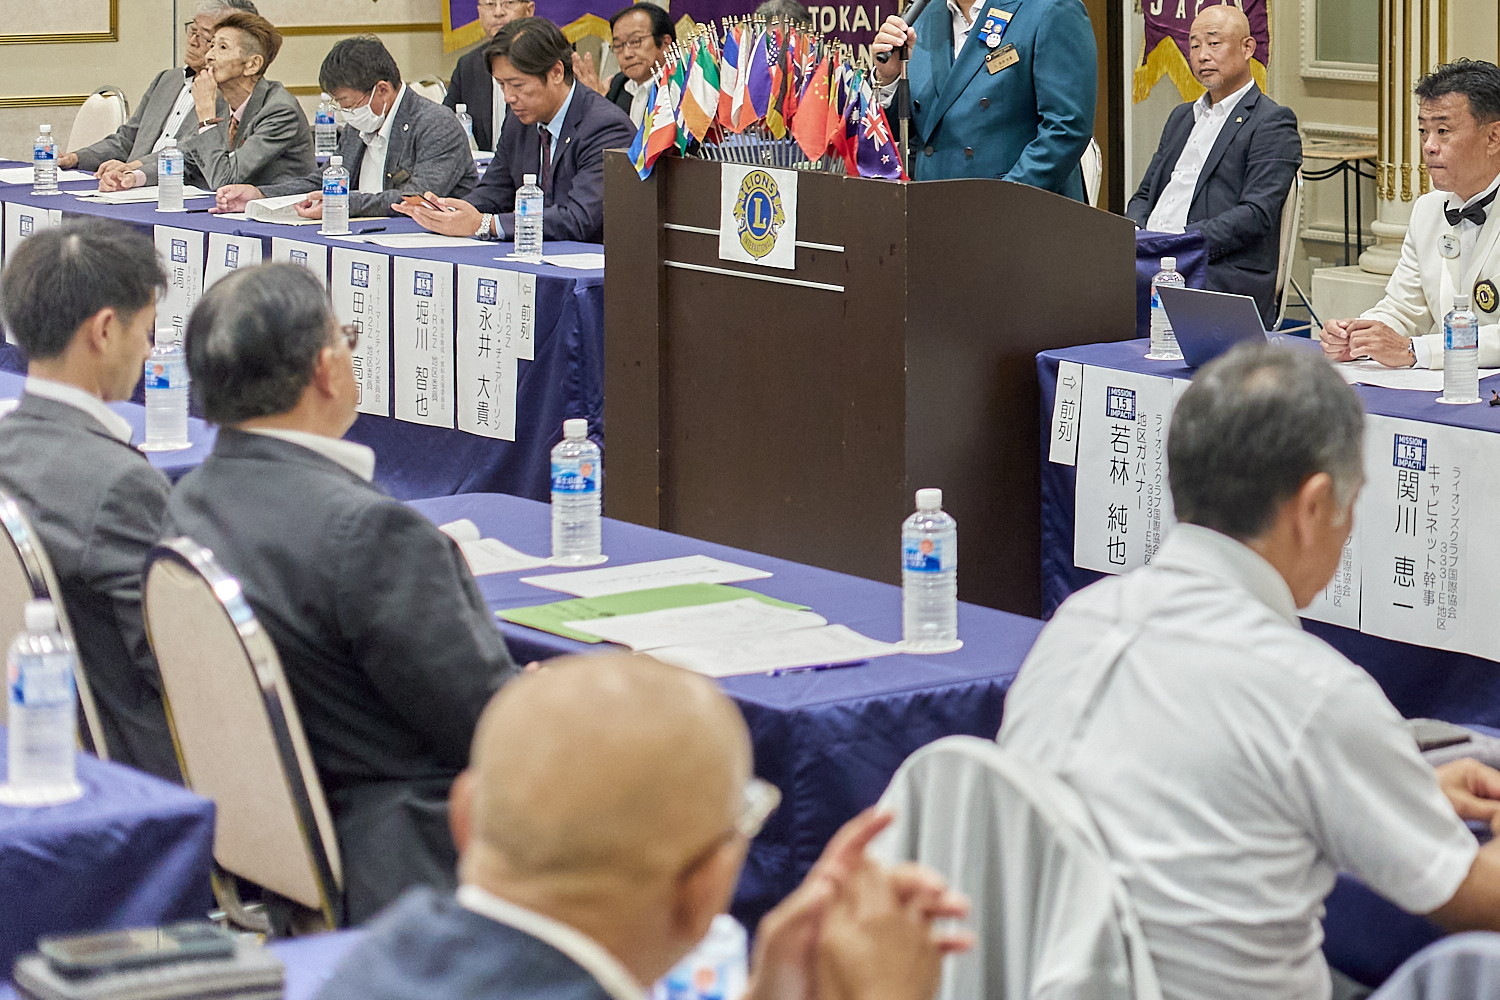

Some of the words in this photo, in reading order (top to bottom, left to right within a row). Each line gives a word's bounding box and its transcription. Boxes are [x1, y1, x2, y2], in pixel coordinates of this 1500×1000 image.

[808, 5, 880, 33] TOKAI
[745, 173, 775, 194] LIONS
[753, 197, 767, 229] L
[483, 286, 492, 297] 1.5
[352, 291, 364, 340] 田中
[415, 299, 429, 351] 堀川
[478, 306, 492, 358] 永井
[520, 304, 531, 340] 前列
[415, 366, 429, 417] 智也
[477, 374, 491, 427] 大貴
[1110, 387, 1133, 398] MISSION
[1115, 397, 1128, 410] 1.5
[1058, 398, 1076, 443] 前列
[1110, 409, 1132, 420] IMPACT!
[1109, 423, 1131, 486] 若林
[1135, 412, 1147, 510] 地区ガバナー
[1398, 435, 1423, 447] MISSION
[1403, 446, 1416, 459] 1.5
[1396, 459, 1421, 470] IMPACT!
[1394, 469, 1419, 537] 関川
[1106, 502, 1129, 566] 純也
[1422, 464, 1440, 607] キャビネット幹事
[1393, 555, 1416, 609] 恵一
